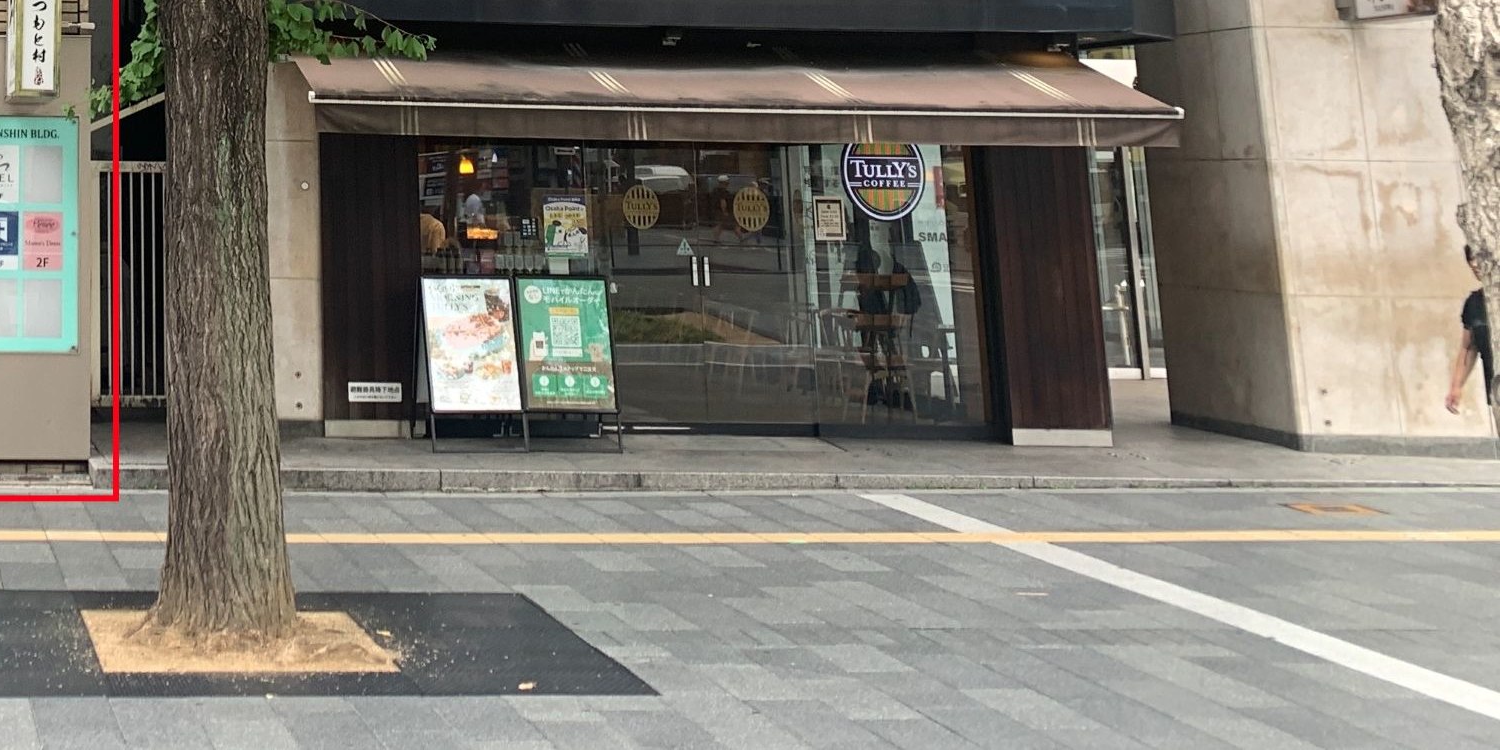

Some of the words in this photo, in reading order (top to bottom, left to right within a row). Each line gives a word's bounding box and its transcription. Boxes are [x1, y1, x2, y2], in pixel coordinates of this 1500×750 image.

[30, 129, 59, 139] BLDG.
[863, 180, 906, 188] COFFEE
[918, 232, 947, 243] SMA
[36, 257, 49, 268] 2F
